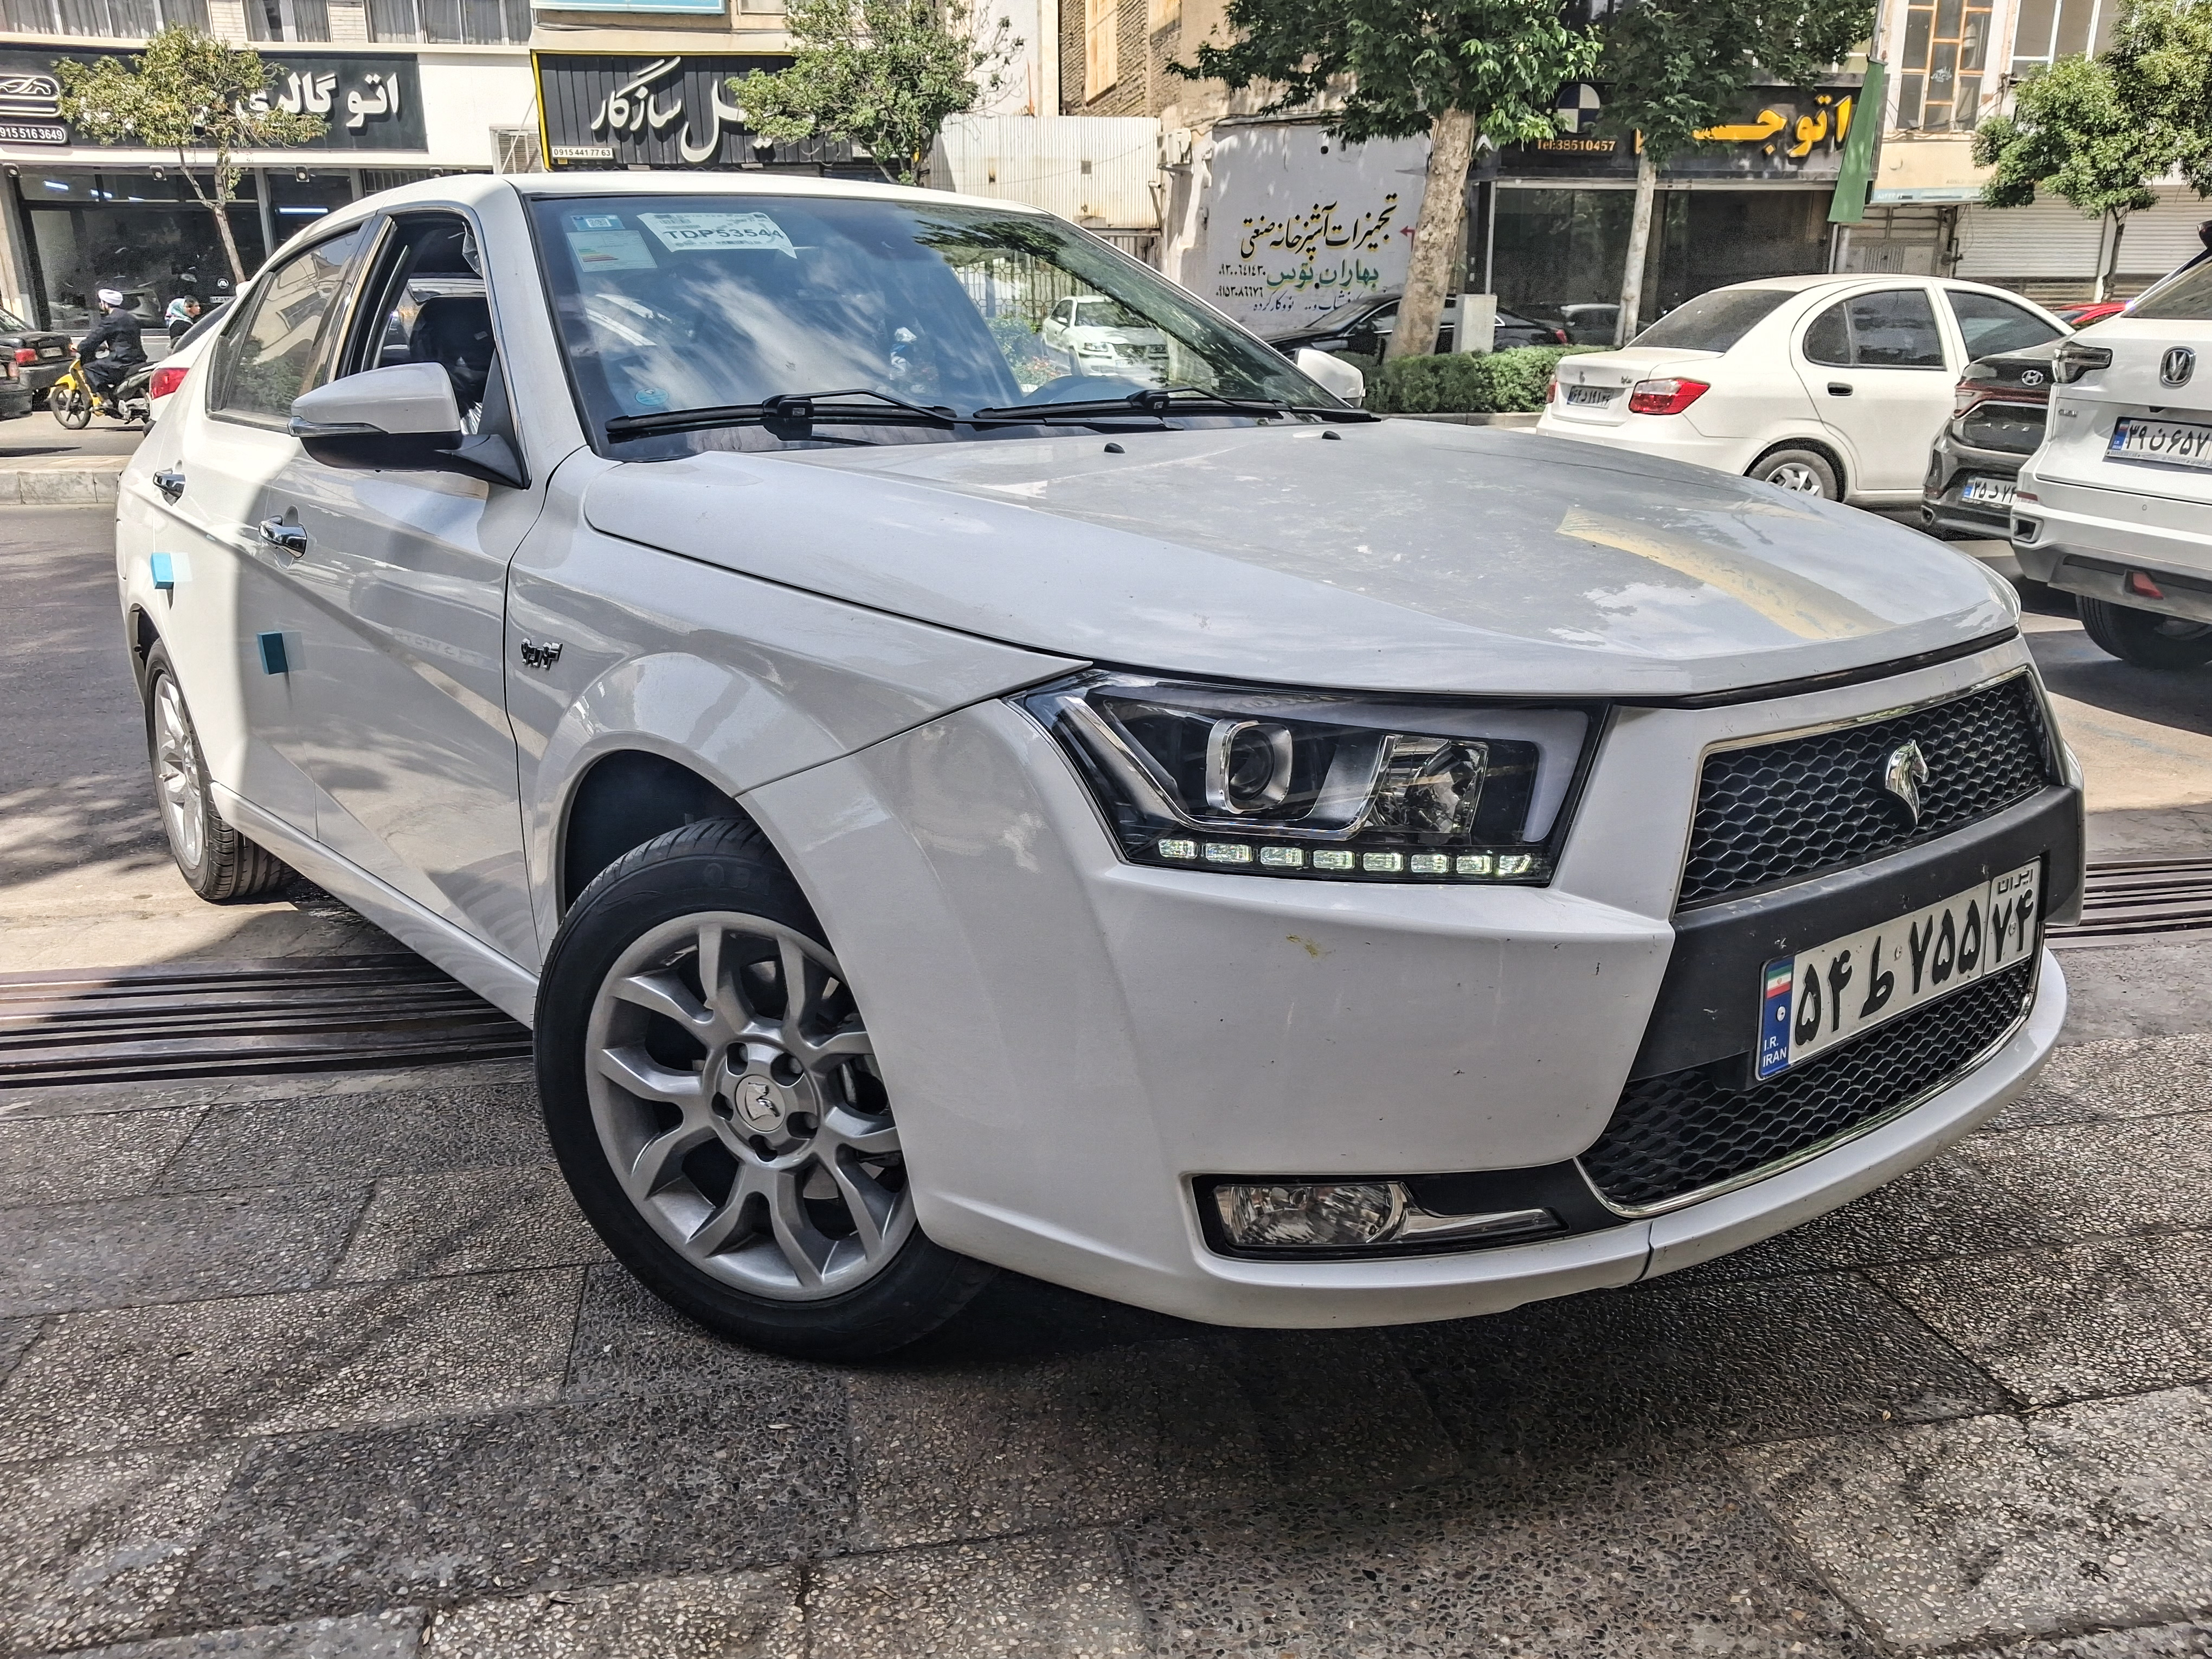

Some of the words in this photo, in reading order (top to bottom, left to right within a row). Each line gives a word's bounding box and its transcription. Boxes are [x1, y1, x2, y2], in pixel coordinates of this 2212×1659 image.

[346, 72, 400, 127] اتو
[591, 56, 682, 131] سازگار
[19, 127, 38, 139] 516
[38, 128, 63, 139] 3649
[1789, 94, 1852, 158] اتو
[1240, 215, 1276, 259] صنعتی
[1325, 192, 1397, 250] تجهیزات
[1266, 262, 1314, 290] توس
[1319, 259, 1380, 290] بهاران
[1997, 868, 2033, 895] ایران
[1992, 889, 2034, 963] ۷۴
[1763, 1047, 1787, 1067] IRAN
[1764, 1036, 1779, 1052] I.R.
